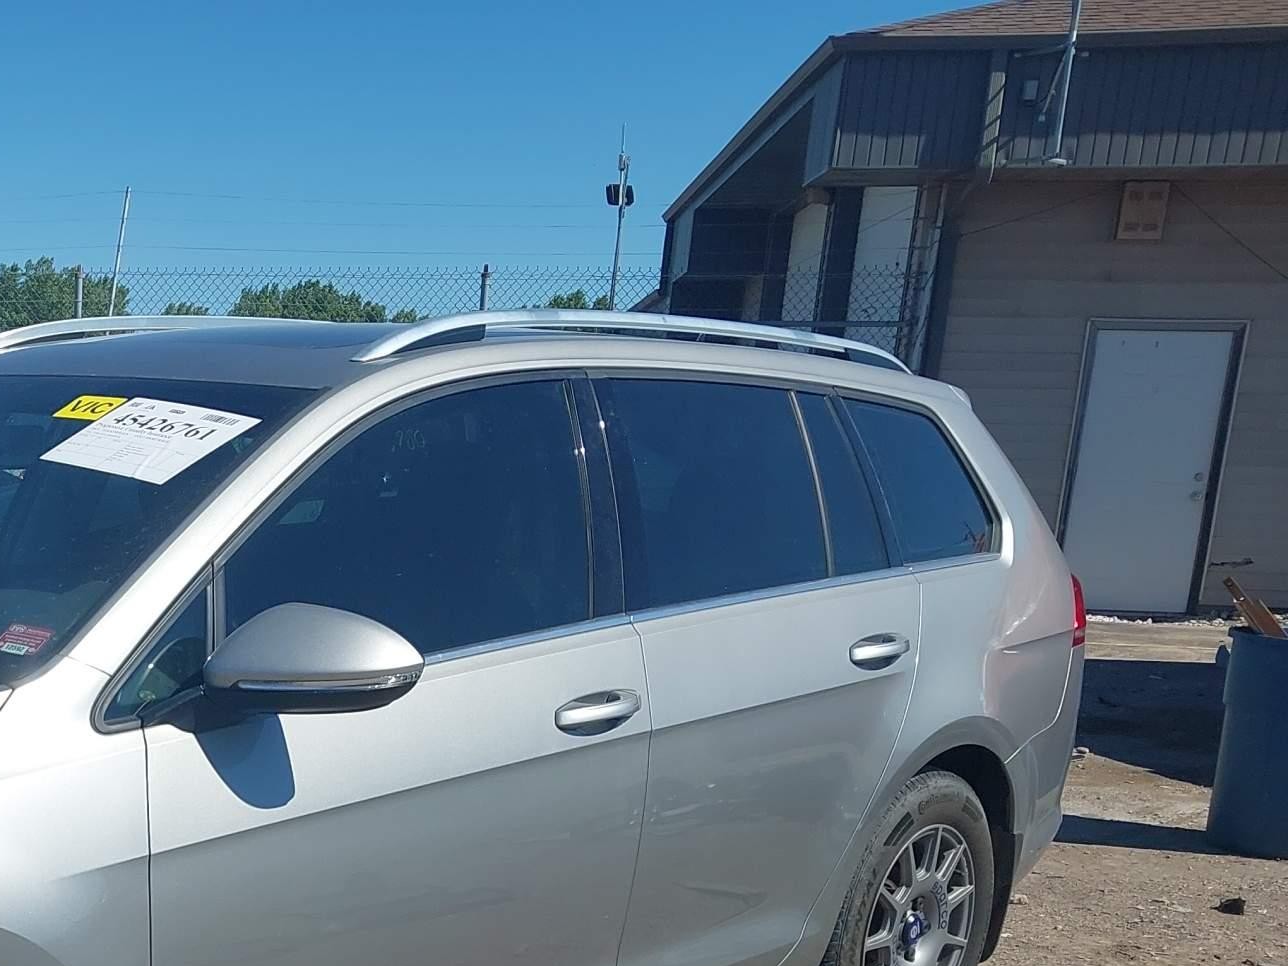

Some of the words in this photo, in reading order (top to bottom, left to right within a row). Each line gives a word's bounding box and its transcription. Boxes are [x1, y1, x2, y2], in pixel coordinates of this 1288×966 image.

[70, 399, 114, 414] VIC
[113, 412, 218, 441] 45426761
[931, 880, 948, 930] sparco
